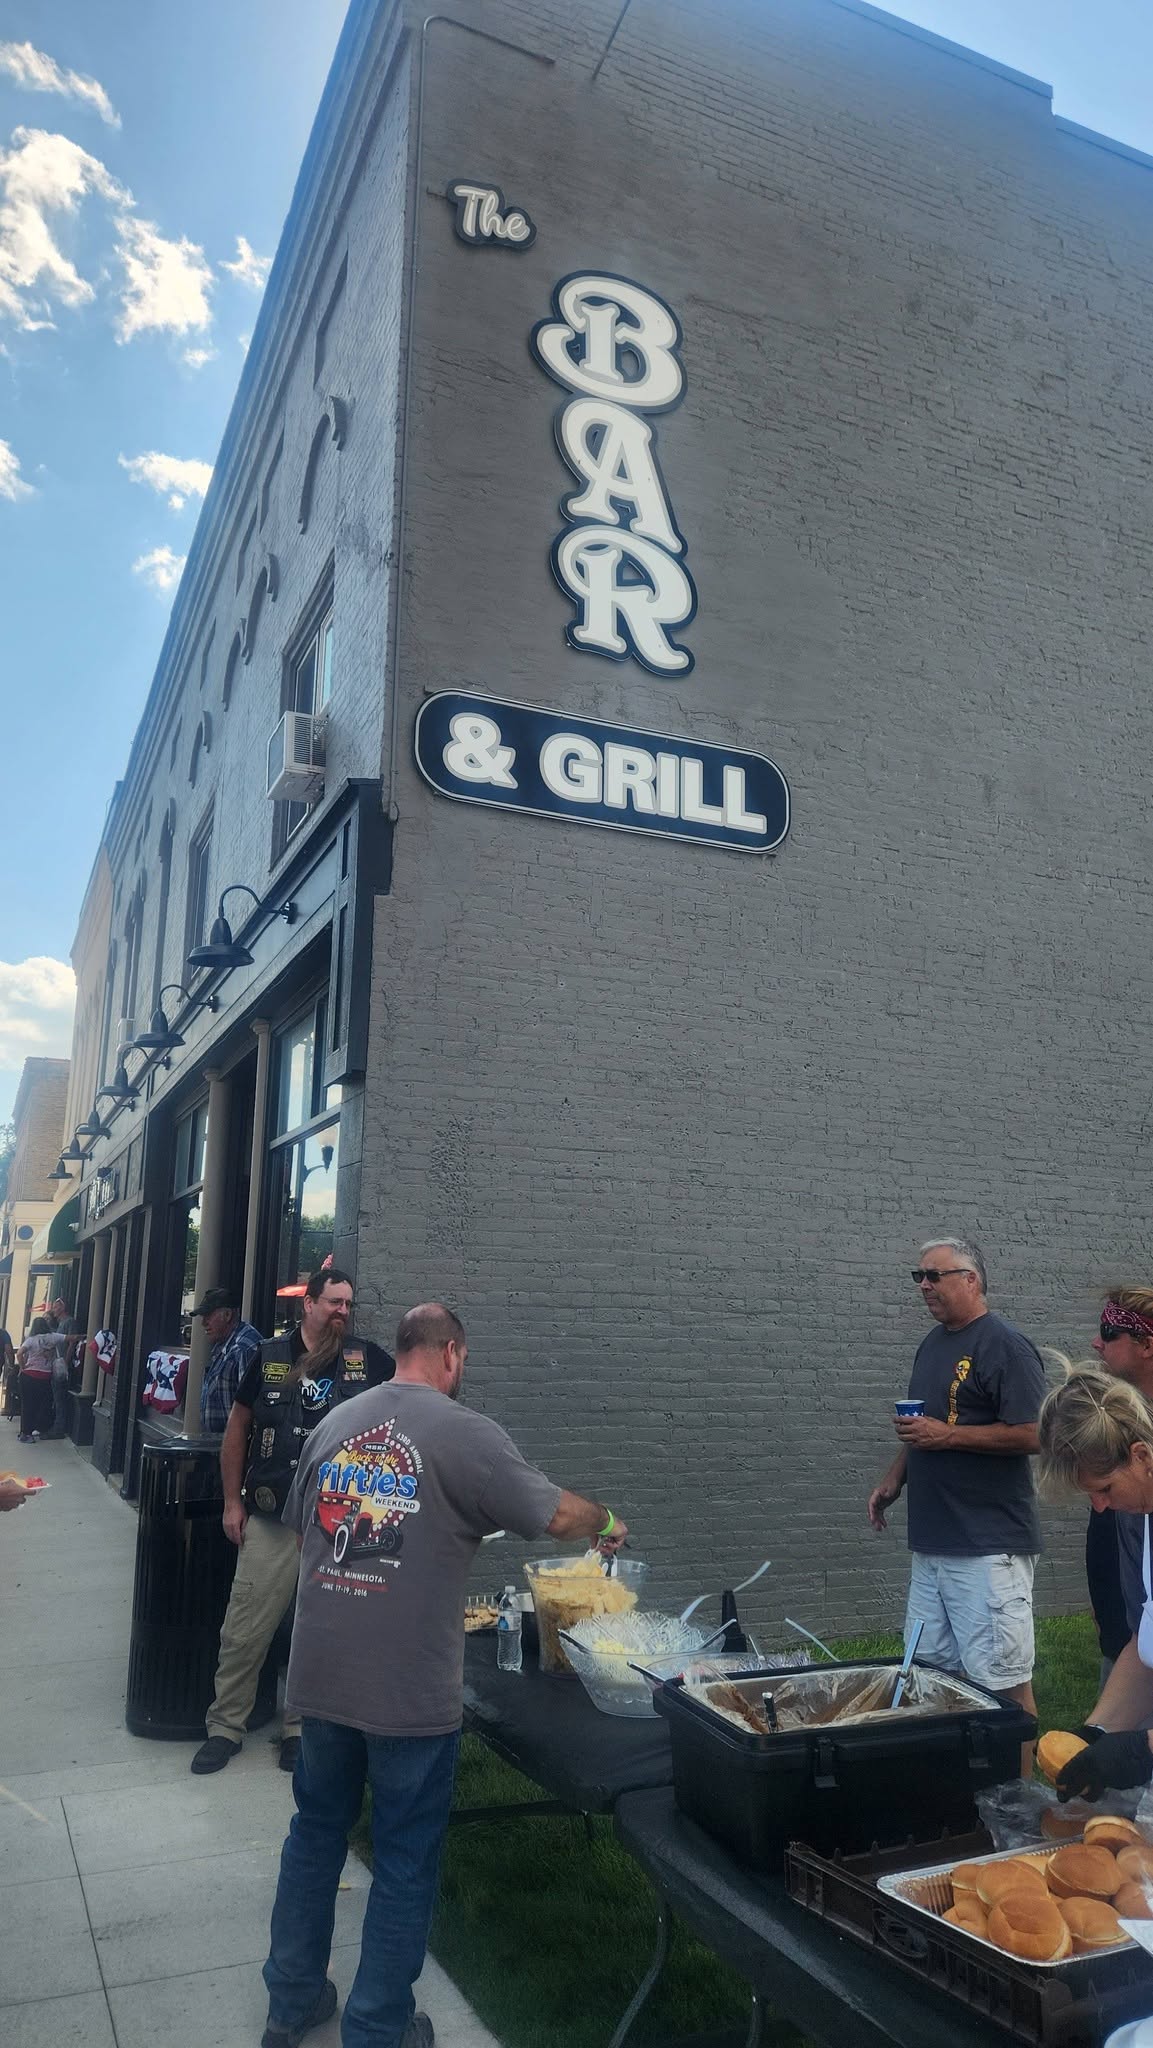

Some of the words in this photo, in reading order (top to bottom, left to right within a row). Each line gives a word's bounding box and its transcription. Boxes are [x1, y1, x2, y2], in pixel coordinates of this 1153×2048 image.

[454, 185, 531, 242] The
[536, 274, 693, 672] BAR
[443, 712, 519, 790] &
[539, 732, 768, 835] GRILL
[347, 1450, 373, 1462] Back
[375, 1453, 384, 1464] to
[384, 1453, 400, 1465] the
[409, 1445, 424, 1475] ANNUAL
[317, 1461, 418, 1499] fifties
[375, 1497, 416, 1510] WEEKEND
[321, 1582, 334, 1591] JUNE
[353, 1588, 368, 1597] 2016
